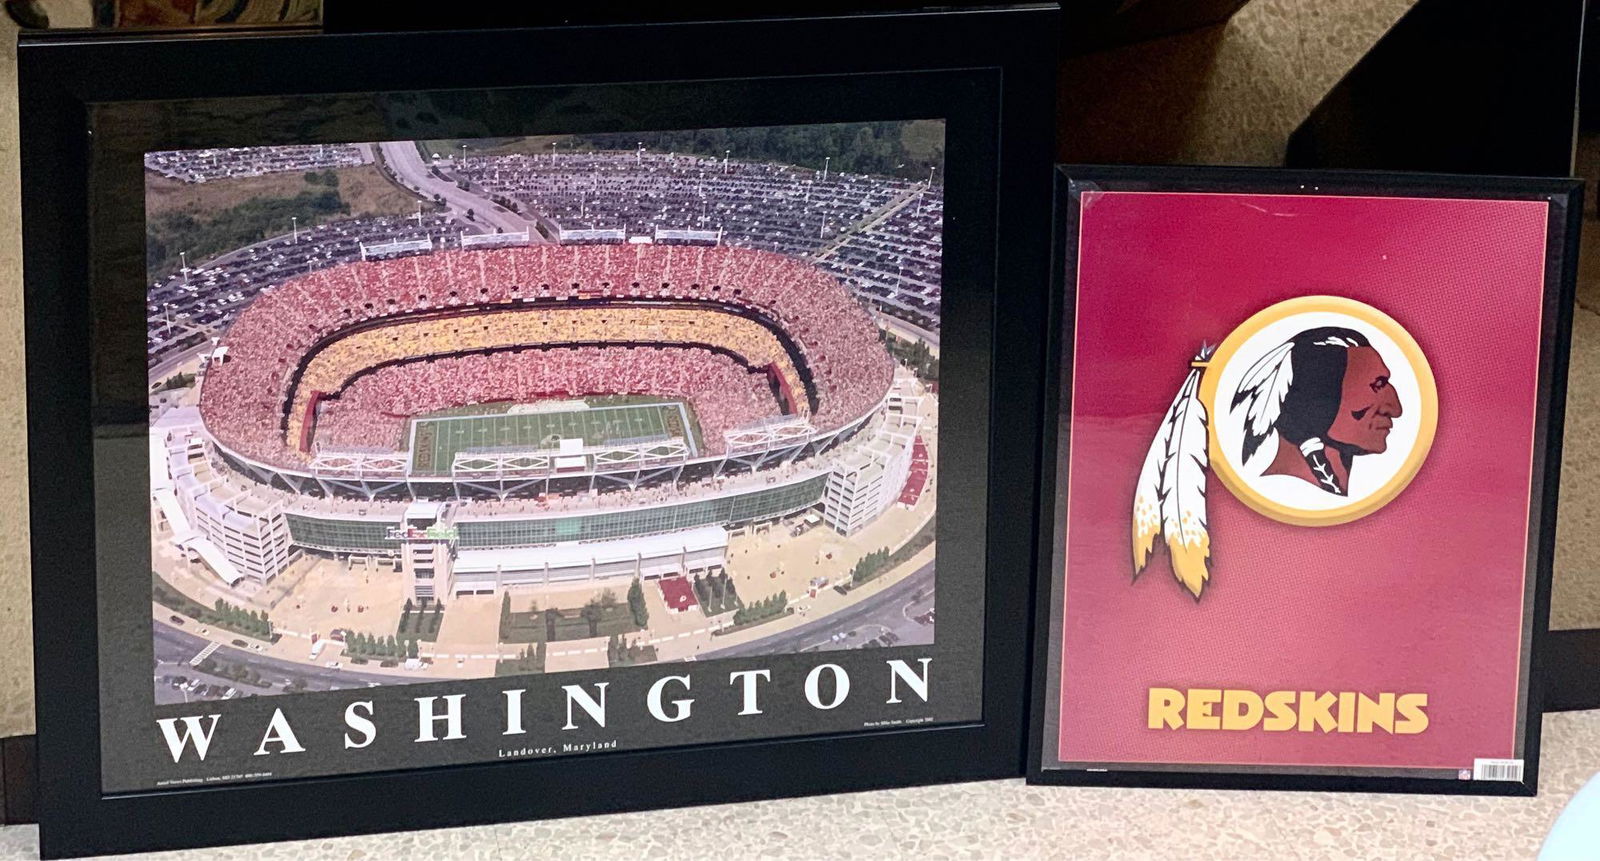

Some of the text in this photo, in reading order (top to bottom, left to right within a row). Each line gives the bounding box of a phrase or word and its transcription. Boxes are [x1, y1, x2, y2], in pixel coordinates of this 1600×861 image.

[156, 657, 933, 764] WASHINGTON
[1147, 687, 1429, 734] REDSKINS
[498, 740, 618, 758] Landover, Maryland
